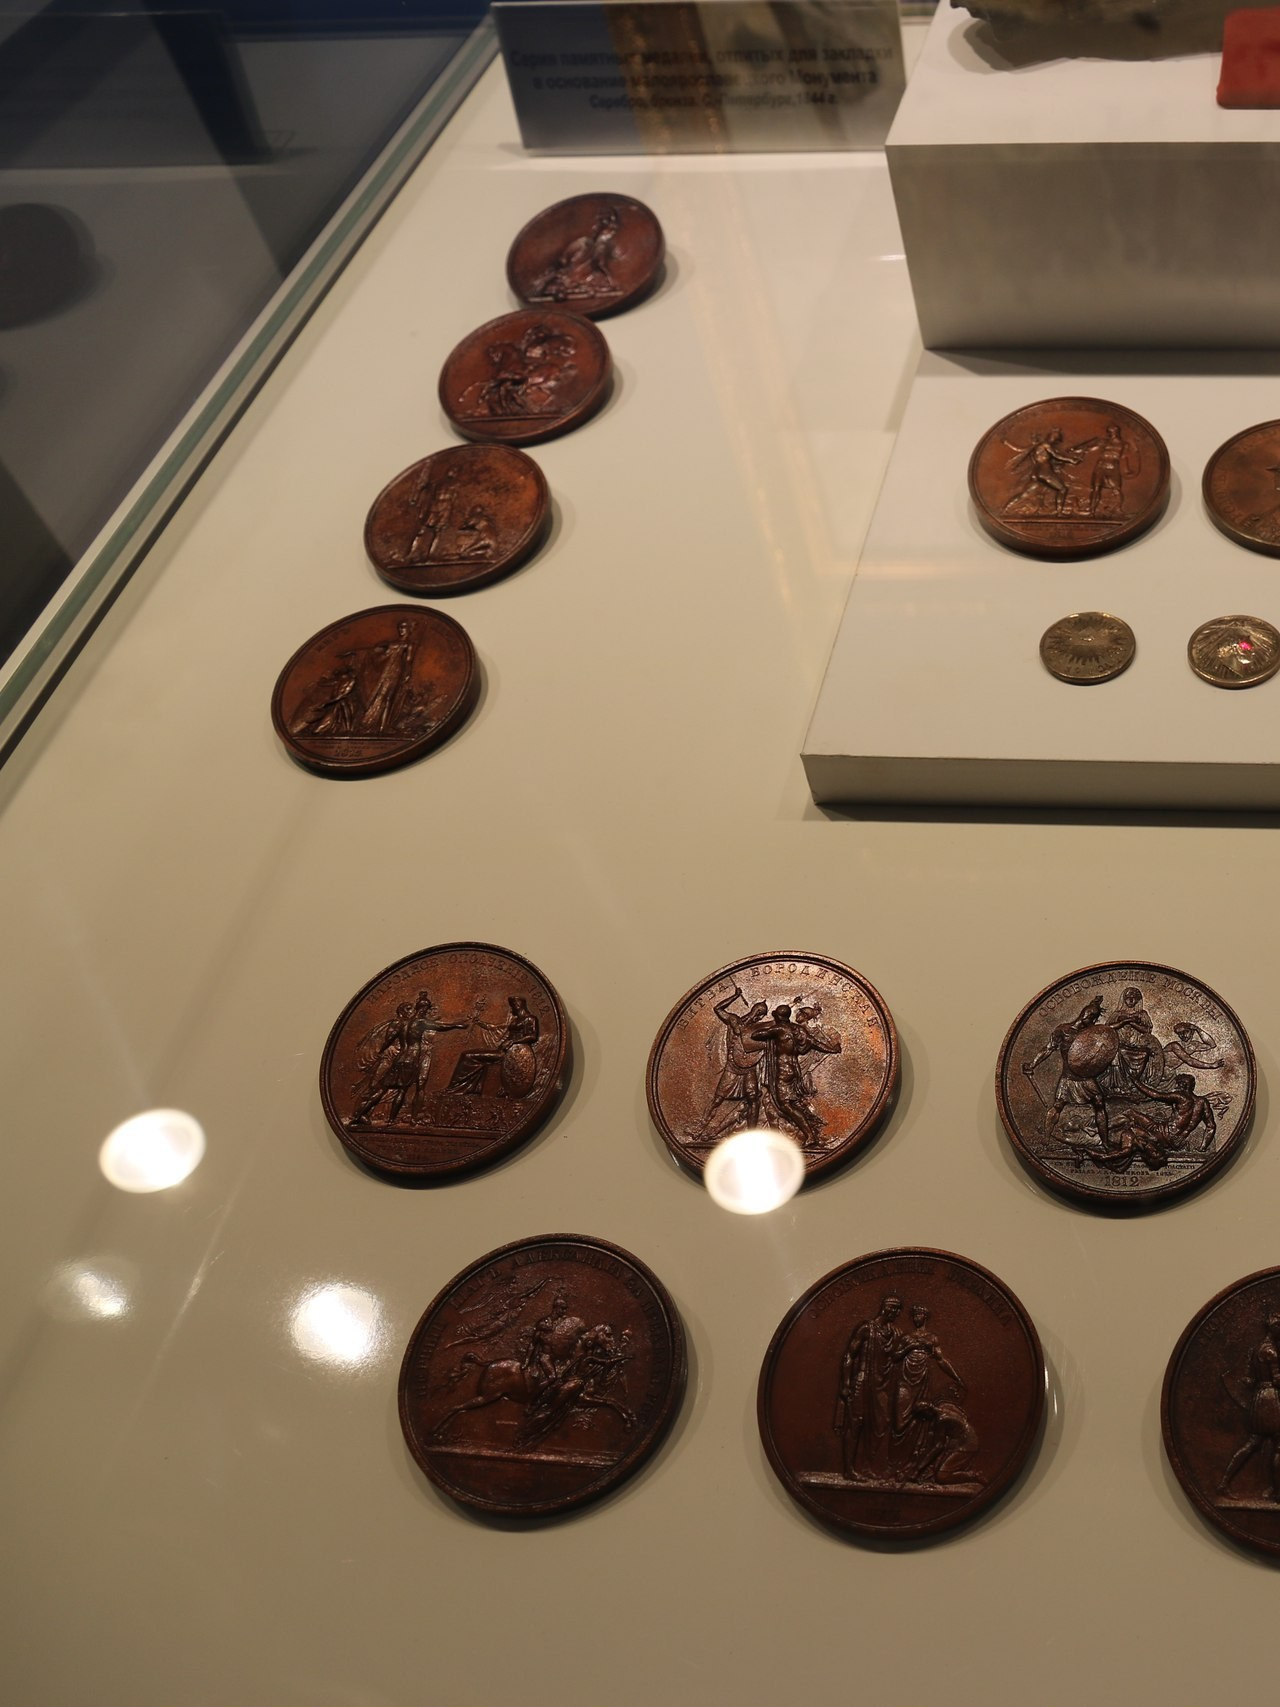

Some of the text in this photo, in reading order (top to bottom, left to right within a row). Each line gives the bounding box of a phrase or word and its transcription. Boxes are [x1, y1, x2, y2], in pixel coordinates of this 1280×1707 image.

[788, 46, 818, 64] для
[1164, 977, 1226, 1021] МОСКВЫ
[1104, 1176, 1140, 1188] 1812
